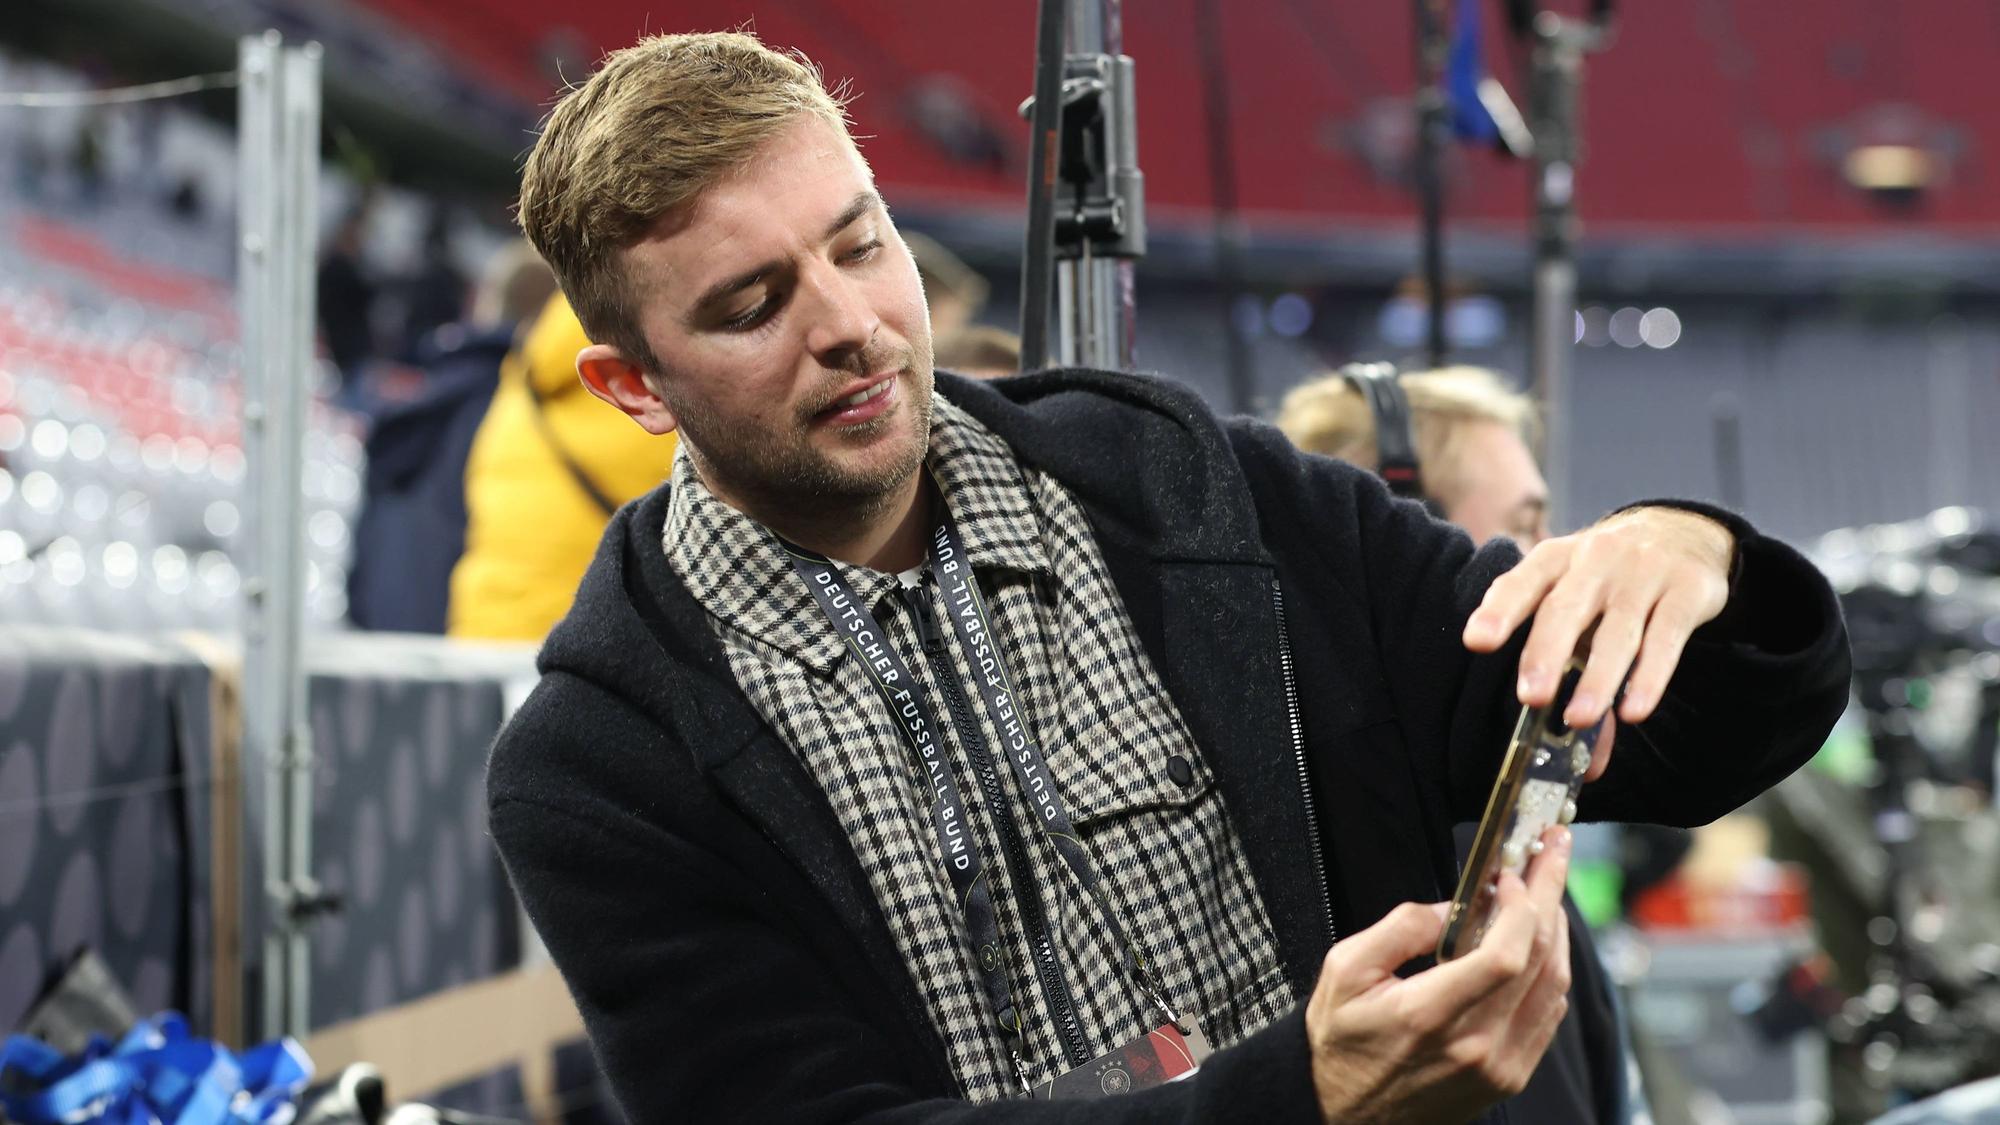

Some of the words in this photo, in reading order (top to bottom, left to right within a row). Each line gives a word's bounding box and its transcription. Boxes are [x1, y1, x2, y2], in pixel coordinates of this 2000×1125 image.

[935, 525, 1001, 687] FUSSBALL-BUND
[815, 571, 899, 684] DEUTSCHER
[894, 689, 969, 870] FUSSBALL-BUND
[995, 691, 1057, 821] DEUTSCHER
